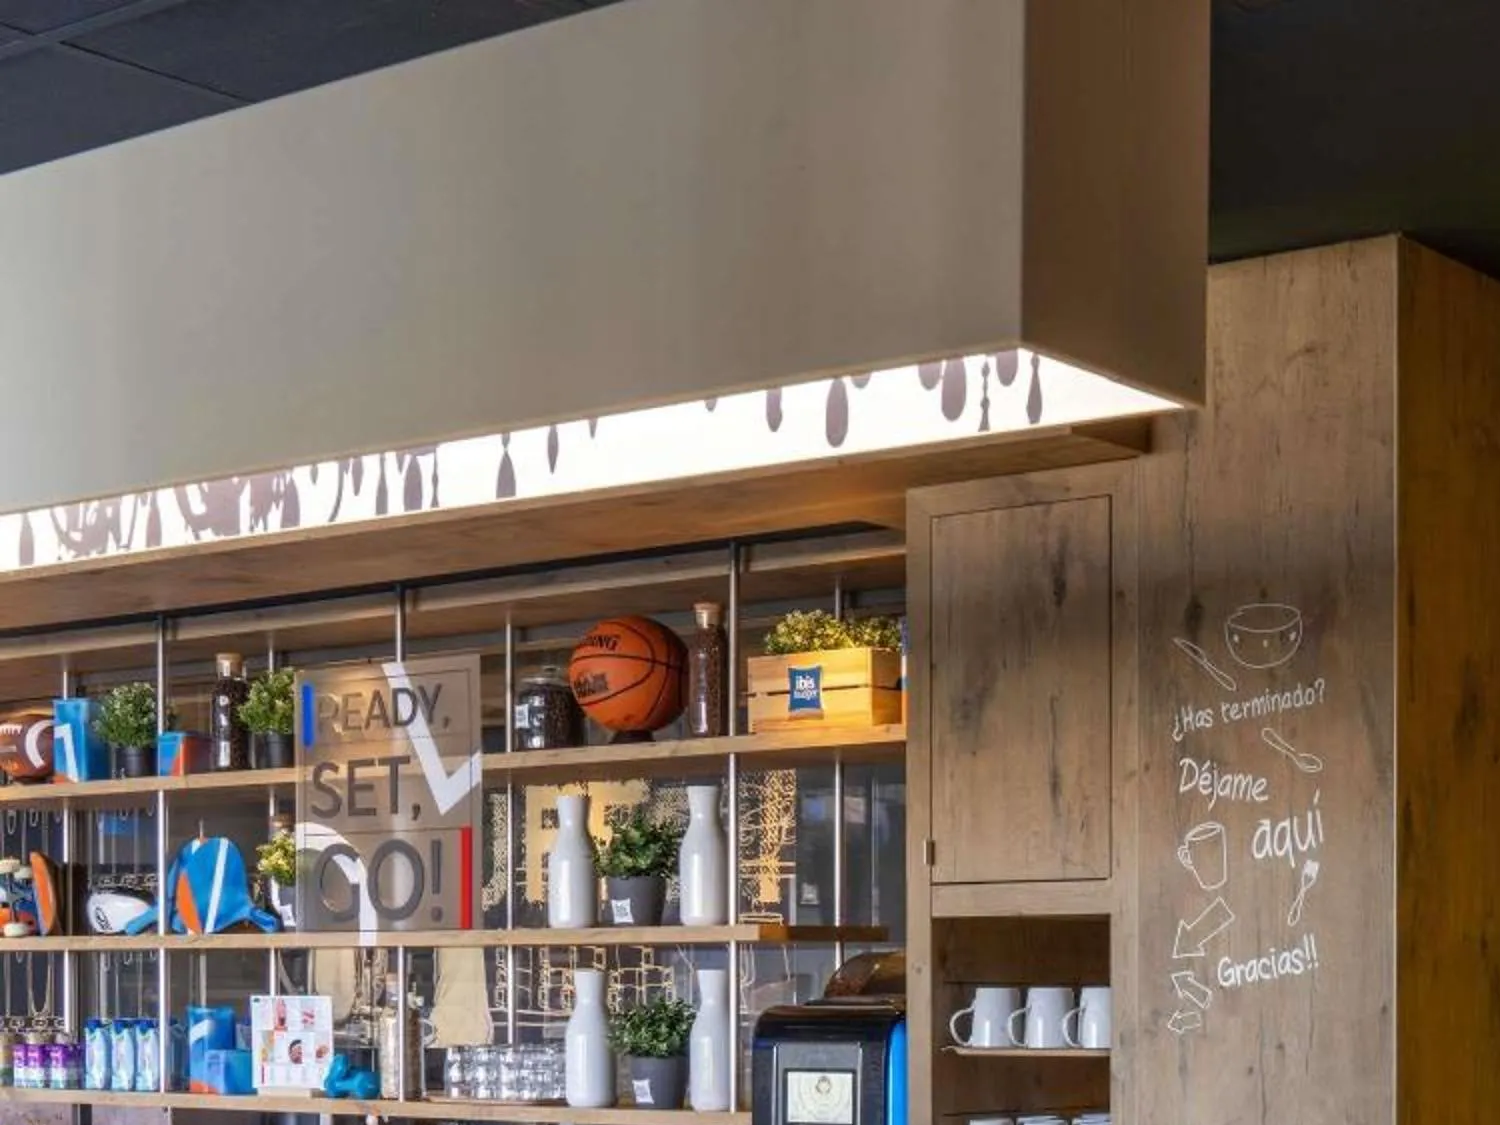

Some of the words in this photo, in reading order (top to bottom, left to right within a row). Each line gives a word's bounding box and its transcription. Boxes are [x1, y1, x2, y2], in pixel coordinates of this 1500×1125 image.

[316, 683, 452, 731] READY,
[1172, 705, 1213, 742] ¿Has
[1221, 678, 1325, 724] terminado?
[311, 755, 421, 821] SET,
[1178, 757, 1270, 811] Déjame
[1252, 789, 1325, 867] aquí
[314, 839, 443, 923] GO!
[1217, 934, 1319, 988] Gracias!!
